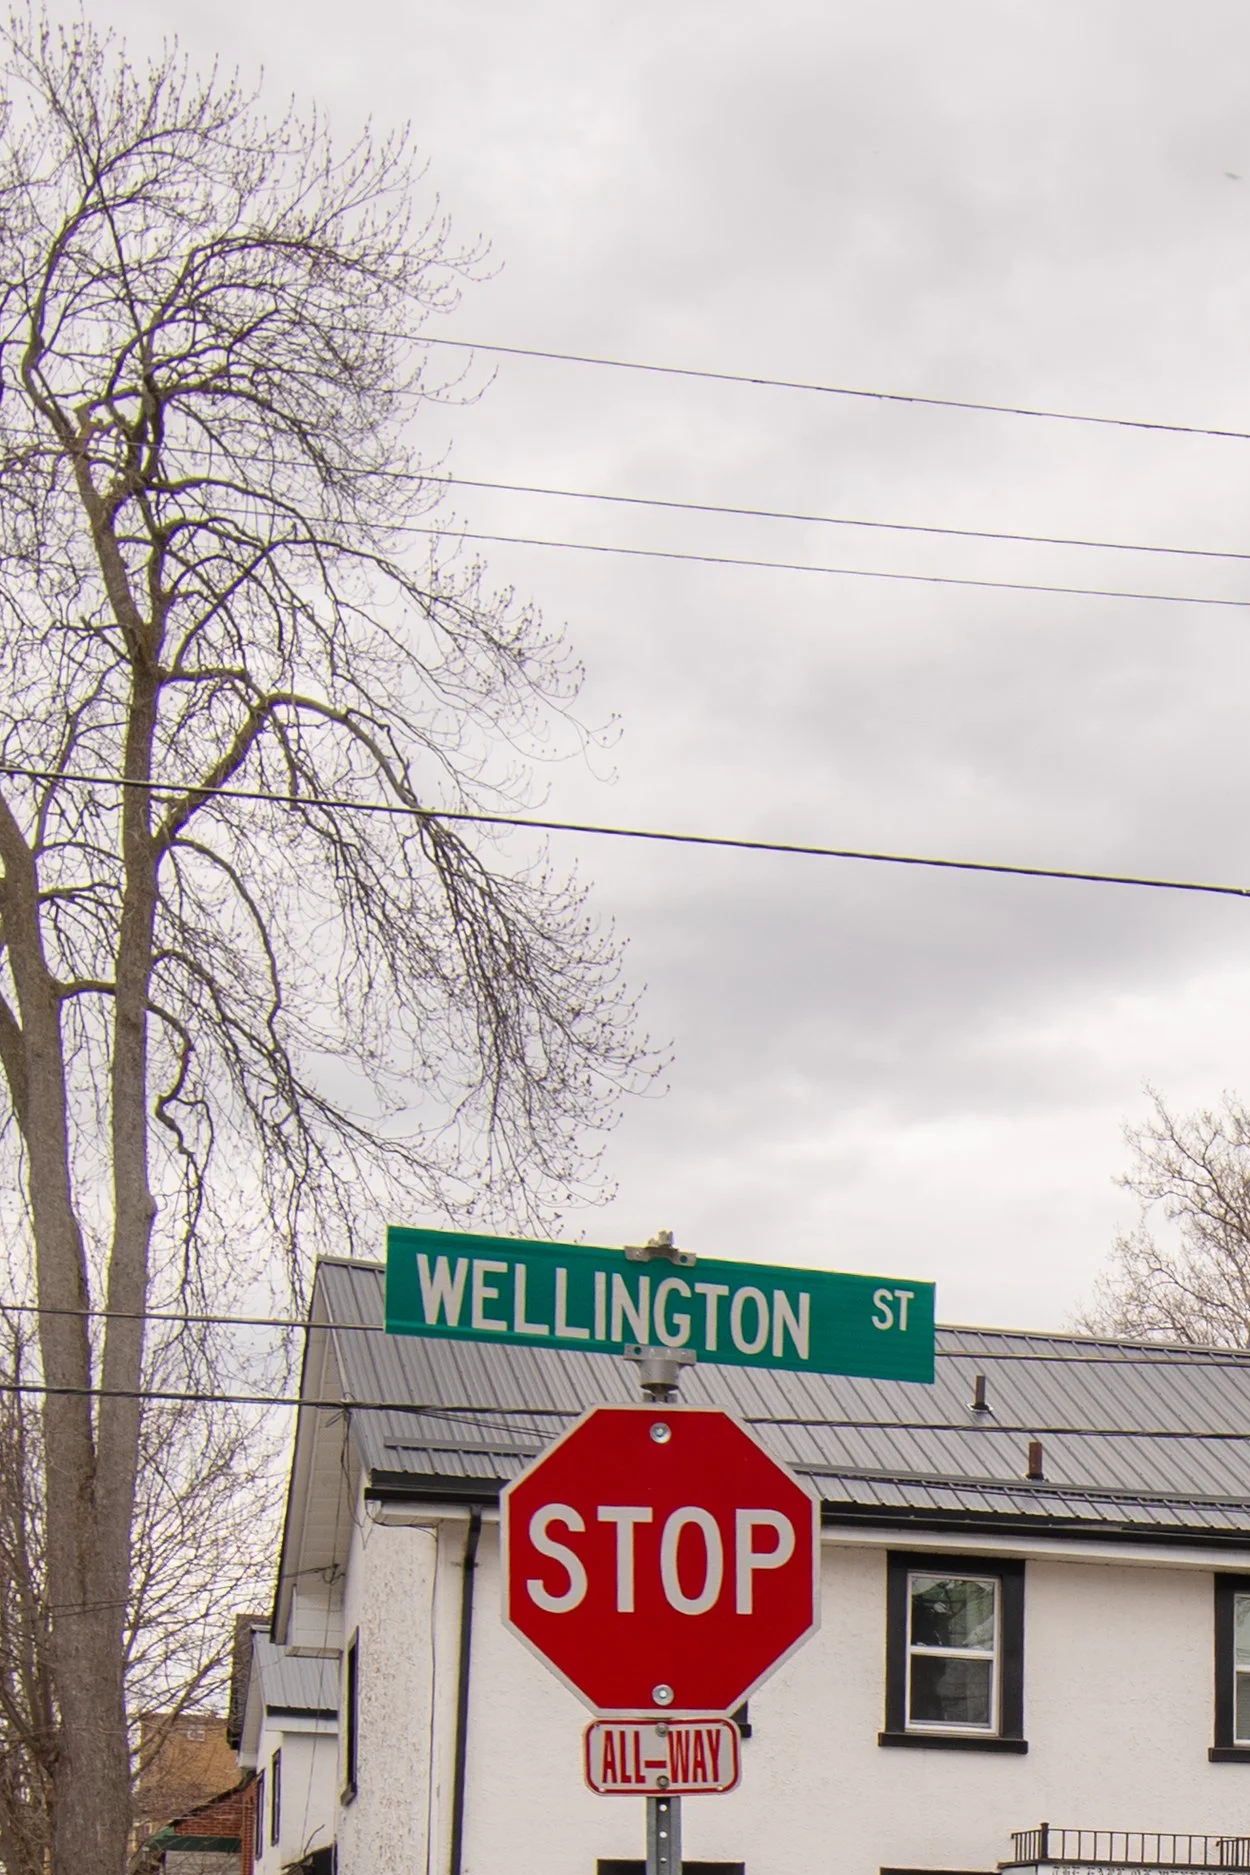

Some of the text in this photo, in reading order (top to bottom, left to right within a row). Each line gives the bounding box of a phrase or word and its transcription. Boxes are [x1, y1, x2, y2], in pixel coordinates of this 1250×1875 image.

[416, 1253, 915, 1360] WELLINGTON ST
[526, 1503, 796, 1616] STOP
[602, 1729, 721, 1784] ALL-WAY
